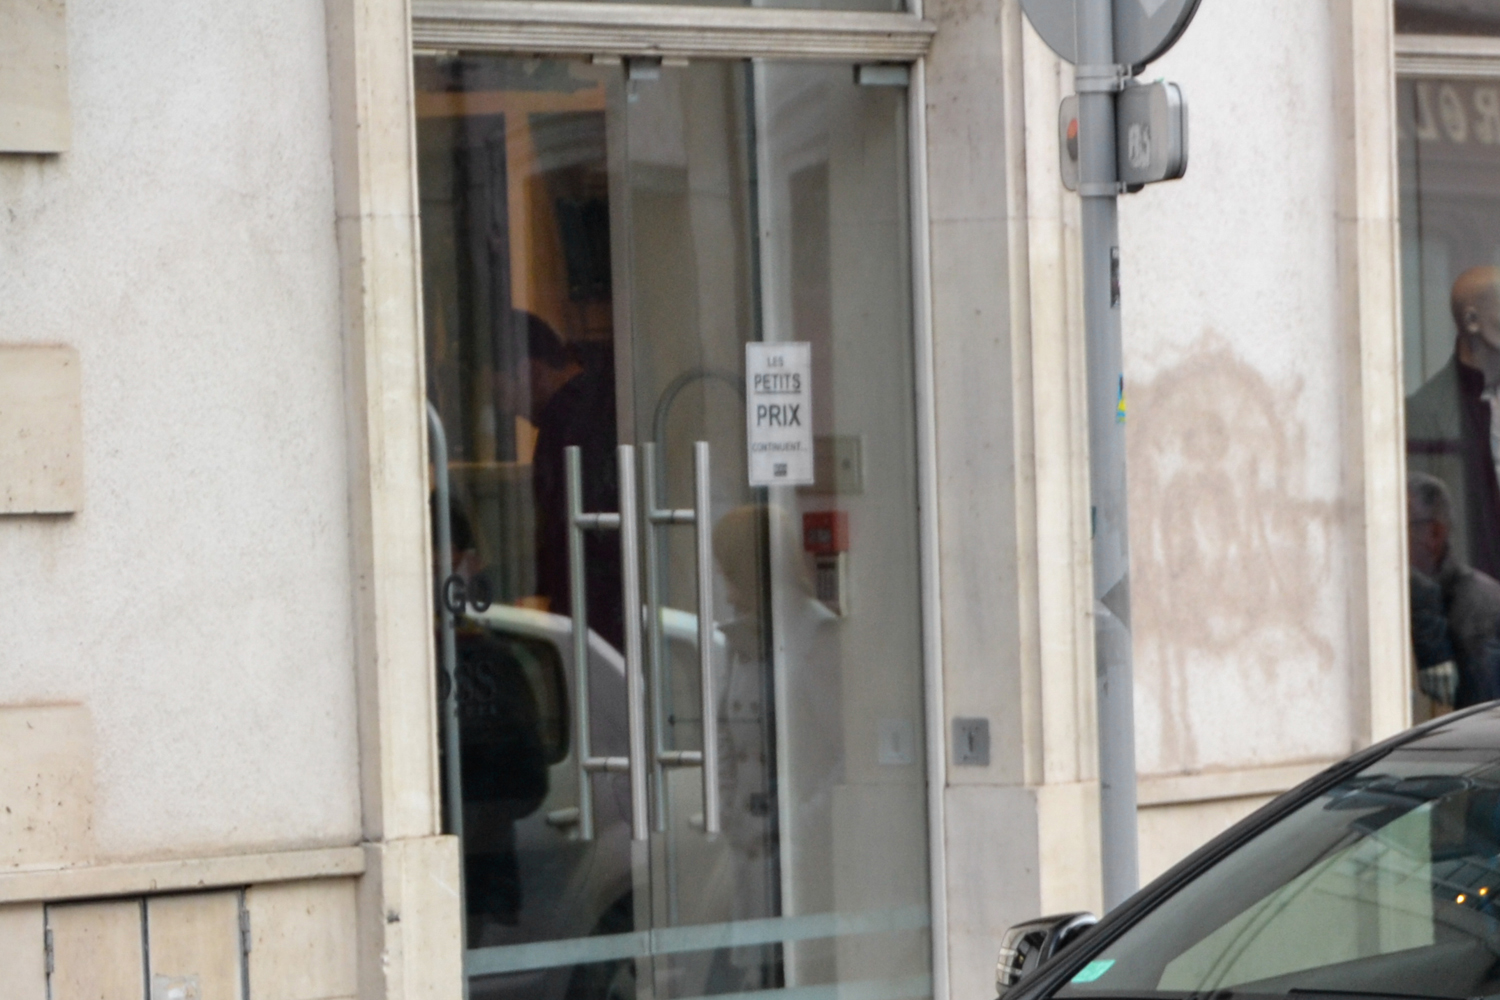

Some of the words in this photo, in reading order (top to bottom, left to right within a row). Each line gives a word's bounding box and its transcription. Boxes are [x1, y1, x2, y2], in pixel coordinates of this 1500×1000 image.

[766, 355, 784, 368] LES
[754, 372, 802, 390] PETITS
[756, 403, 802, 427] PRIX
